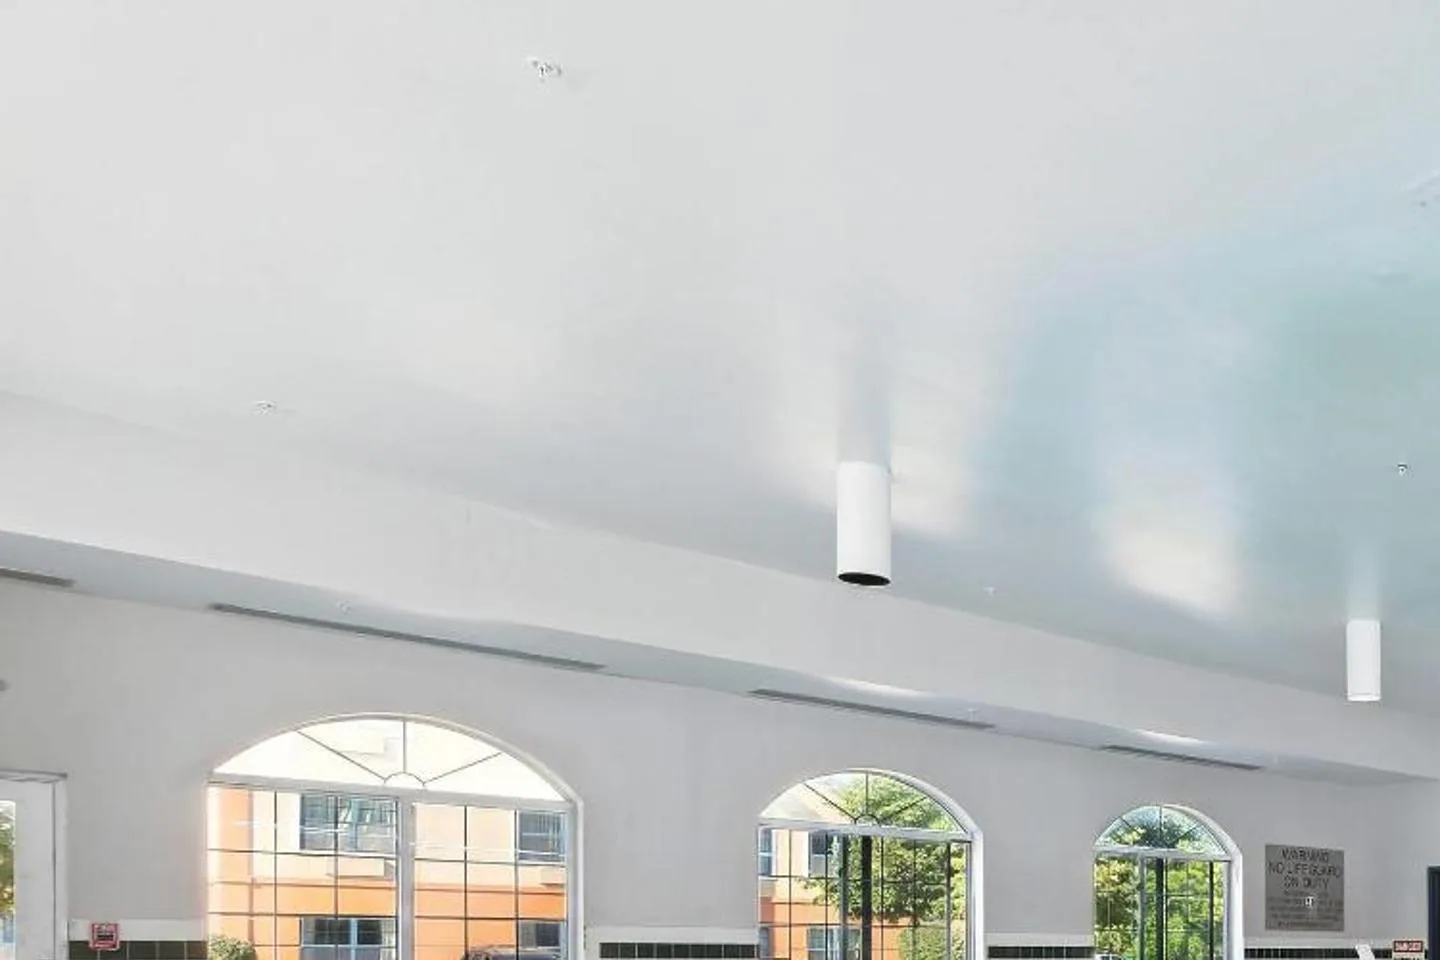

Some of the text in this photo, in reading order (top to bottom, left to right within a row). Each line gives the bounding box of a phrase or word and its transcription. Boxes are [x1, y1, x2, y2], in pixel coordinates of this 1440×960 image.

[1267, 862, 1284, 875] NO
[1283, 875, 1330, 891] ON DUTY
